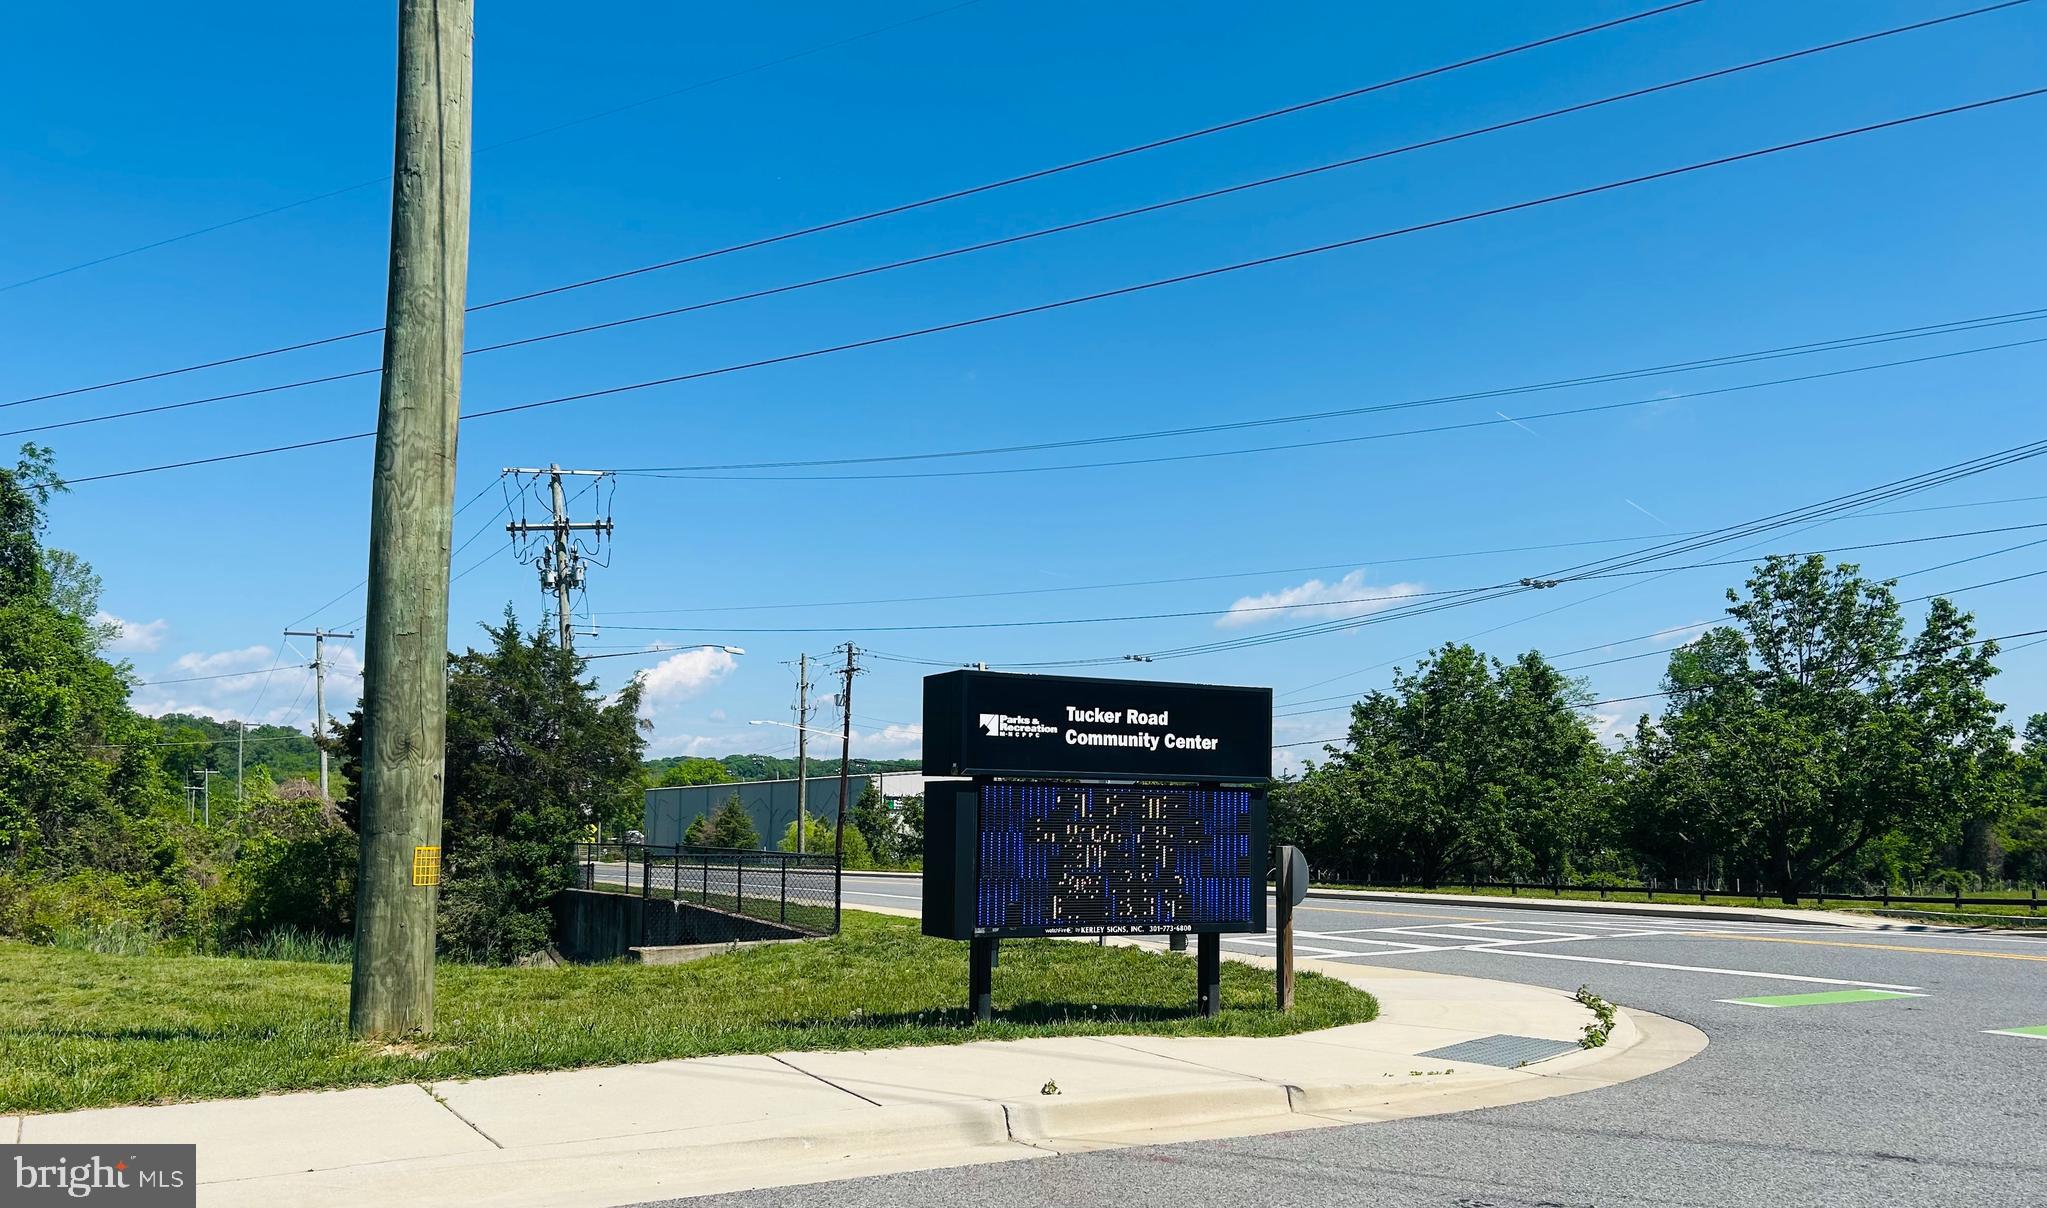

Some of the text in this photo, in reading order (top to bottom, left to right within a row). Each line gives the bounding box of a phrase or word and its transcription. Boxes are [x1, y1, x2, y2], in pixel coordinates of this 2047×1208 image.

[999, 714, 1030, 725] Parks
[1066, 706, 1169, 726] Tucker Road
[999, 722, 1058, 733] Recreation
[1065, 728, 1218, 751] Community Center
[1080, 926, 1105, 934] KERLEY
[1149, 924, 1192, 932] 301-773-6800
